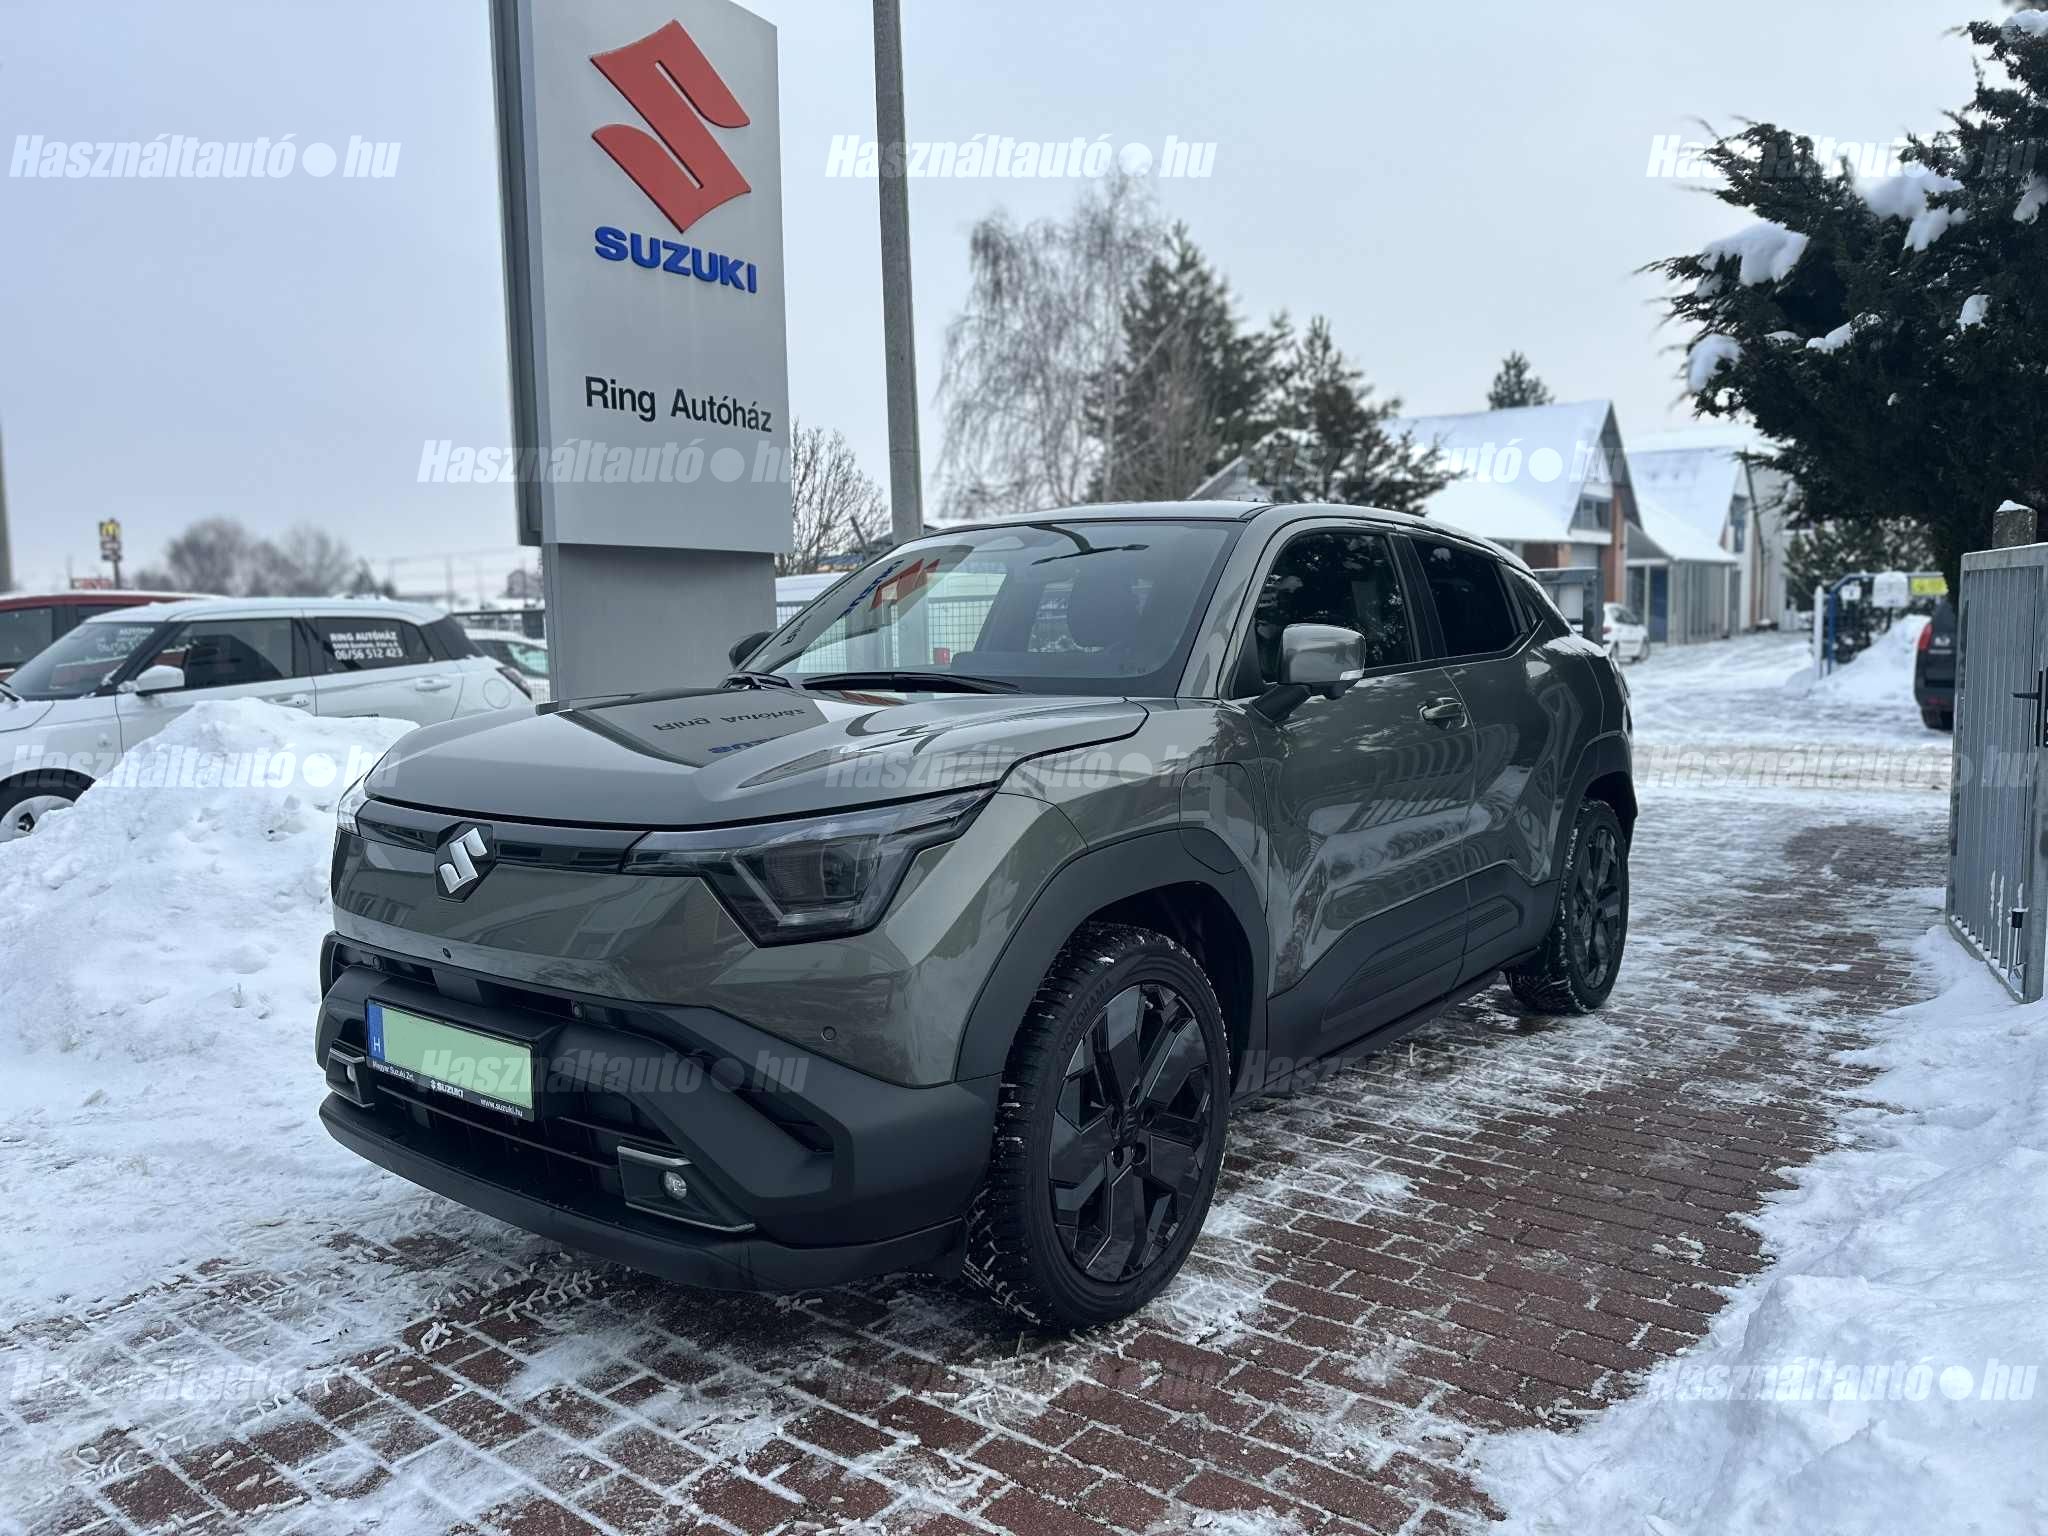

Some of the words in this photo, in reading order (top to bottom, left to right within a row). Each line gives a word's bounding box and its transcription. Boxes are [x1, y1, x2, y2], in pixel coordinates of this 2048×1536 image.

[594, 226, 757, 294] SUZUKI
[585, 376, 656, 422] Ring
[670, 388, 772, 432] Autóház
[366, 647, 384, 659] 512
[385, 647, 404, 658] 423
[373, 1037, 382, 1053] H
[437, 1082, 464, 1099] SUZUKI
[480, 1098, 523, 1117] www.suzuki.hu
